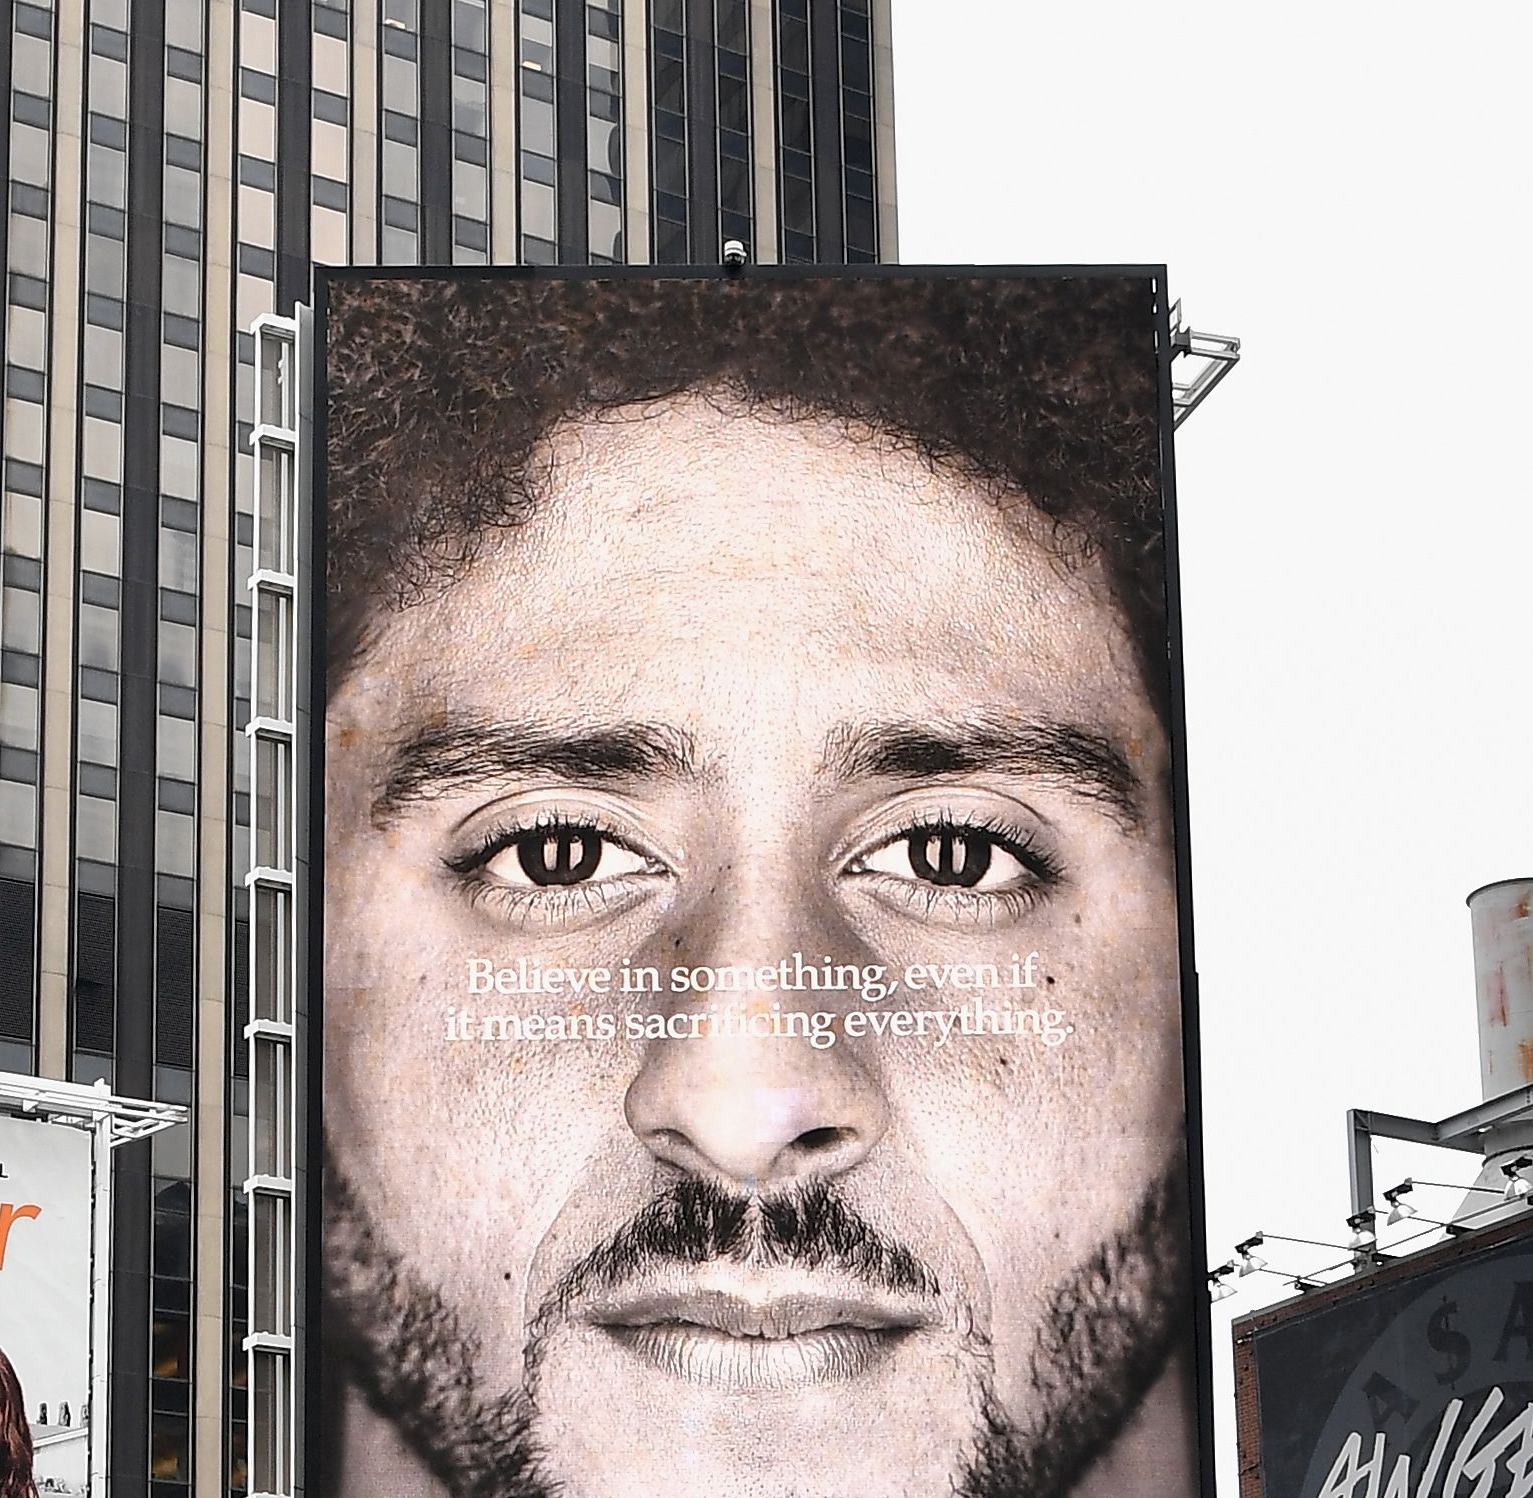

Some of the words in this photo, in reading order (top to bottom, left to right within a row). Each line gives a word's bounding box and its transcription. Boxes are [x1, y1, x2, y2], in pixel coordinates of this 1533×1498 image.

[466, 956, 613, 996] Believe
[620, 956, 662, 995] in
[669, 954, 899, 1003] something,
[906, 960, 1002, 992] even
[1004, 952, 1040, 990] if
[445, 1005, 476, 1044] it
[479, 1011, 616, 1044] means
[626, 1003, 837, 1049] sacrificing
[844, 1000, 1076, 1048] everything.
